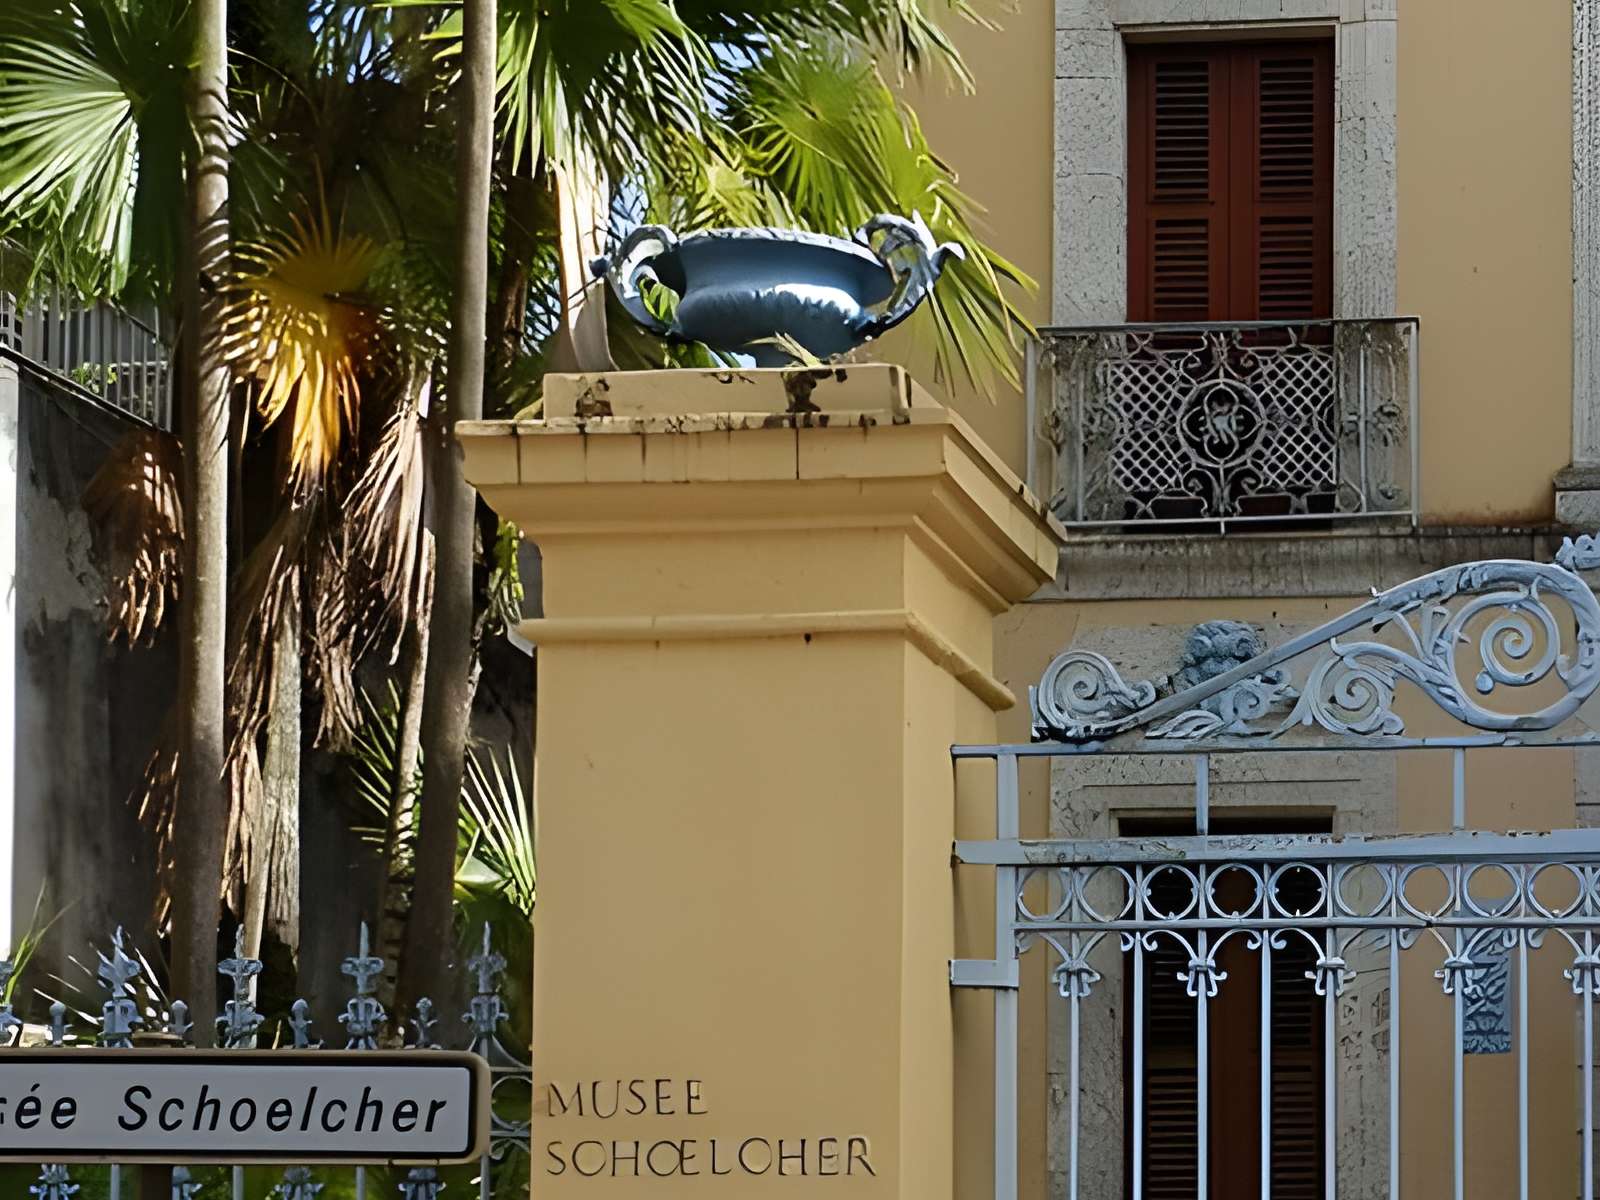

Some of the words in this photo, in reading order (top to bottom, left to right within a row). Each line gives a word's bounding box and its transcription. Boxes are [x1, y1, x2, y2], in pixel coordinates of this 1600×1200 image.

[0, 1082, 78, 1131] ée
[117, 1084, 448, 1133] Schoelcher
[546, 1078, 709, 1119] MUSEE
